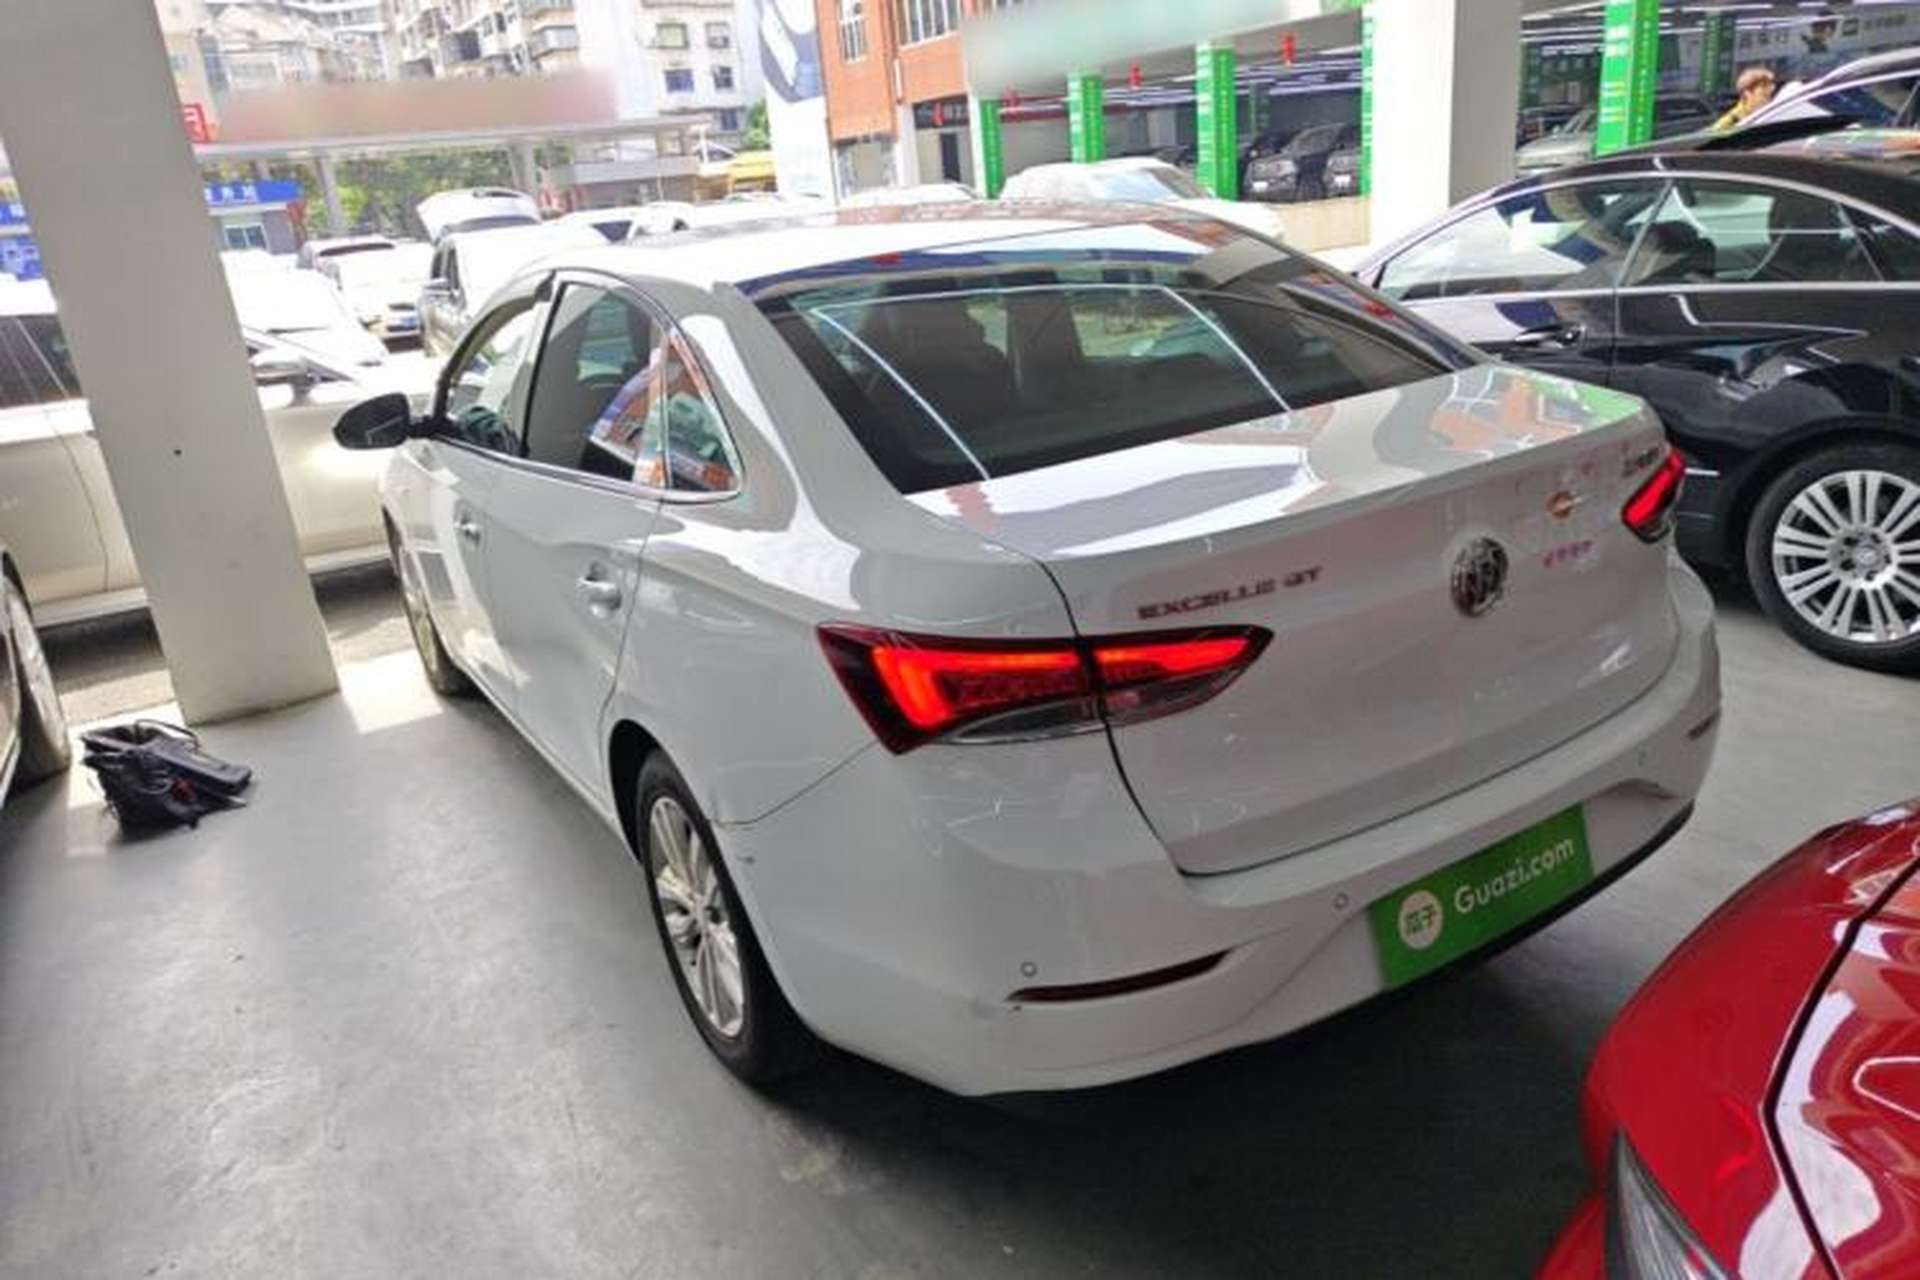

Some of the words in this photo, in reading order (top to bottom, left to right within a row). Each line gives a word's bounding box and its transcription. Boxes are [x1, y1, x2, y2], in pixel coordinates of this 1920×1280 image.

[1137, 578, 1277, 620] EXCELLE
[1282, 565, 1324, 588] GT
[1453, 837, 1575, 914] Guazi.com
[1404, 903, 1438, 935] 瓜子
